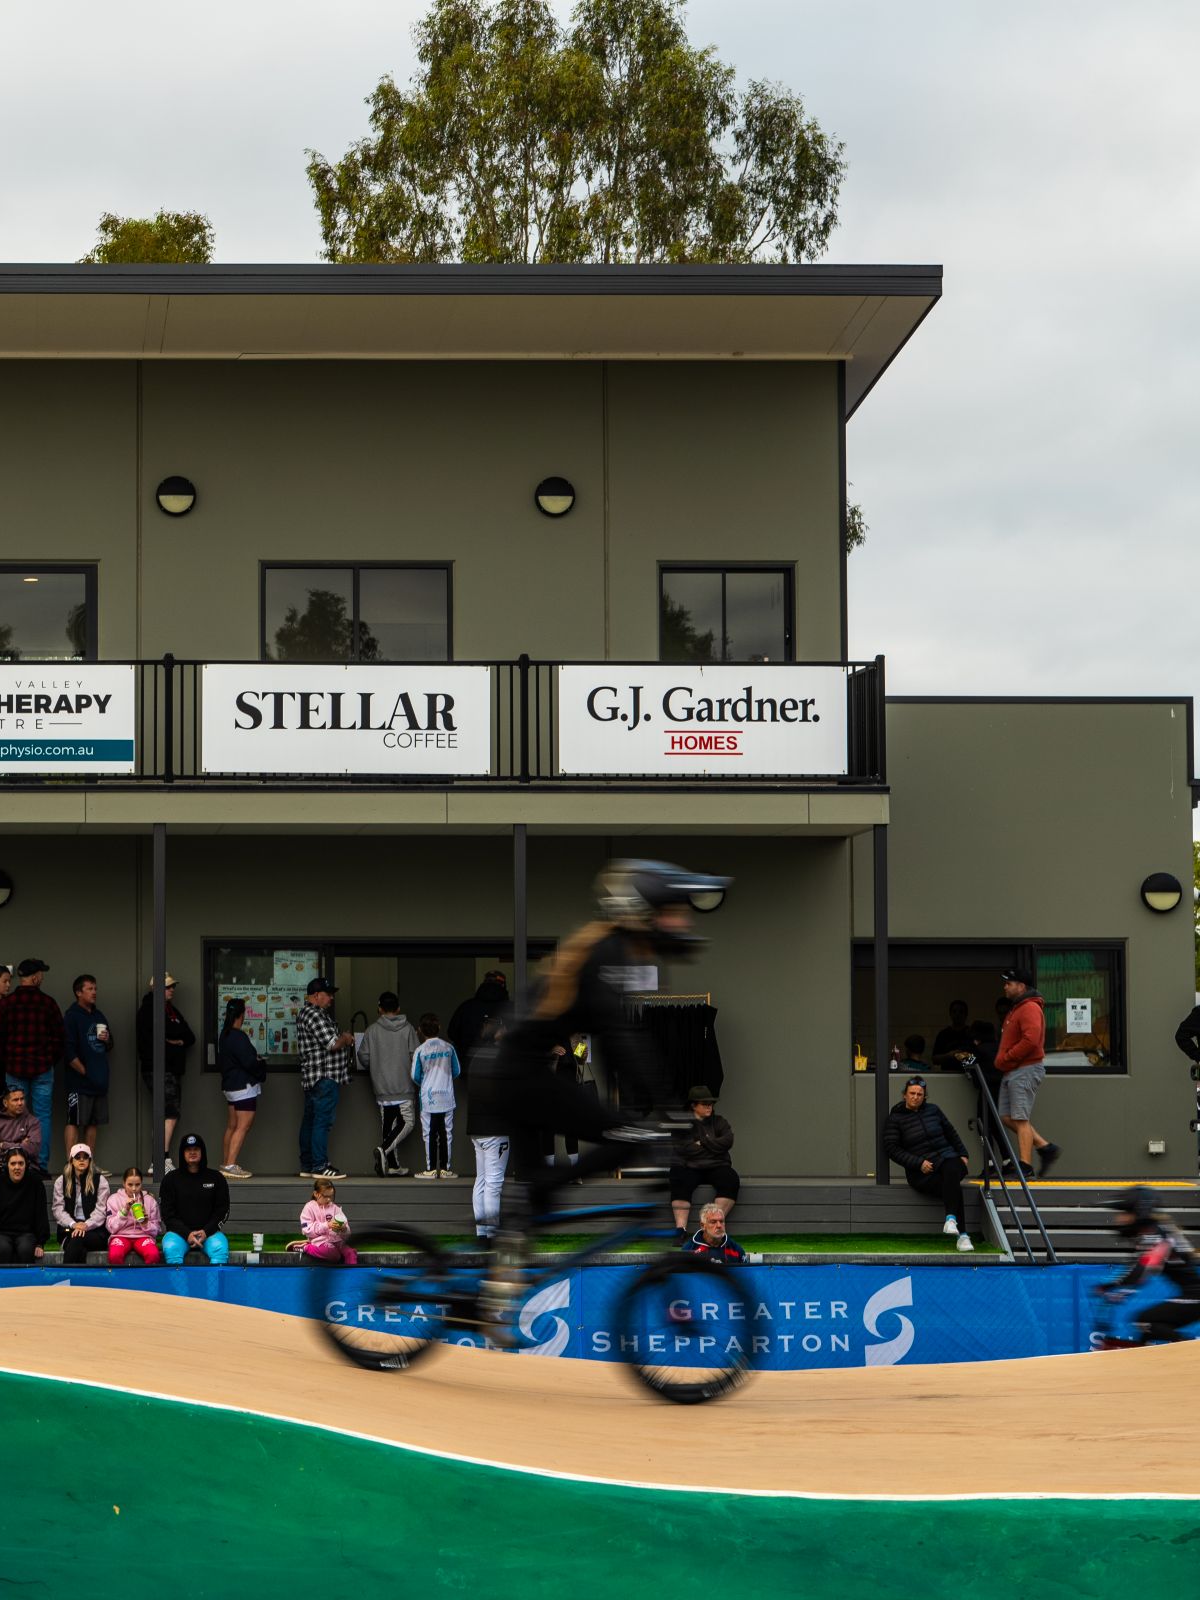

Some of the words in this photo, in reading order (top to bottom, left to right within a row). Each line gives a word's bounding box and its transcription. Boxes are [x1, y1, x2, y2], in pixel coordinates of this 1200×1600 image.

[15, 680, 84, 689] VALLEY
[234, 691, 458, 732] STELLAR
[586, 685, 652, 731] G.J.
[662, 685, 821, 723] Gardner.
[383, 732, 458, 748] COFFEE
[671, 736, 738, 750] HOMES
[668, 1300, 849, 1321] GREATER
[591, 1331, 851, 1353] SHEPPARTON
